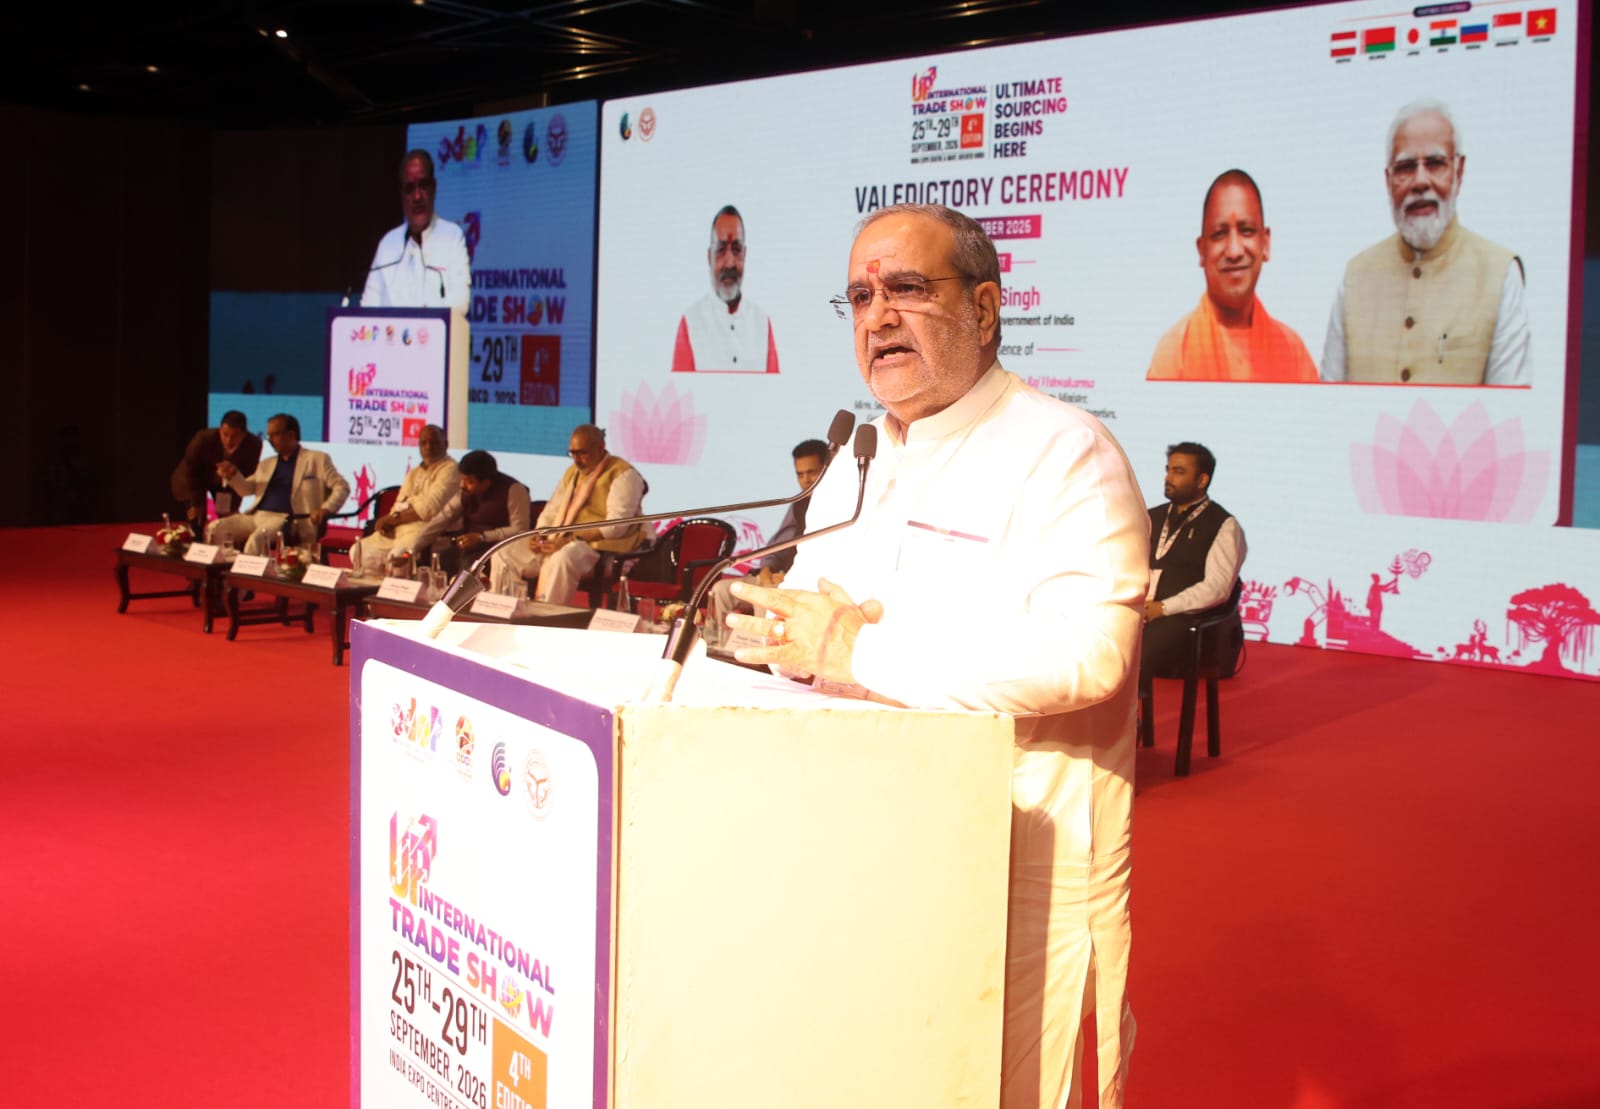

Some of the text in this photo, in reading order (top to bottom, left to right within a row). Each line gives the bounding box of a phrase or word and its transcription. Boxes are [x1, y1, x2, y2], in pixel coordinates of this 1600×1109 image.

[928, 86, 986, 99] INTERNATIONAL
[996, 77, 1062, 99] ULTIMATE
[912, 101, 946, 115] TRADE
[995, 97, 1067, 118] SOURCING
[994, 120, 1043, 138] BEGINS
[994, 141, 1026, 158] HERE
[1000, 167, 1129, 205] CEREMONY
[1006, 219, 1031, 234] 2026
[1000, 286, 1040, 311] Singh
[366, 388, 428, 400] INTERNATIONAL
[349, 399, 387, 412] TRADE
[389, 897, 460, 976] TRADE
[419, 885, 555, 995] INTERNATIONAL
[391, 950, 488, 1056] 25TH-29TH
[390, 1009, 487, 1109] SEPTEMBER, 2026
[508, 1050, 532, 1088] 4TH
[389, 1048, 407, 1077] INDIA
[408, 1065, 425, 1093] EXPO
